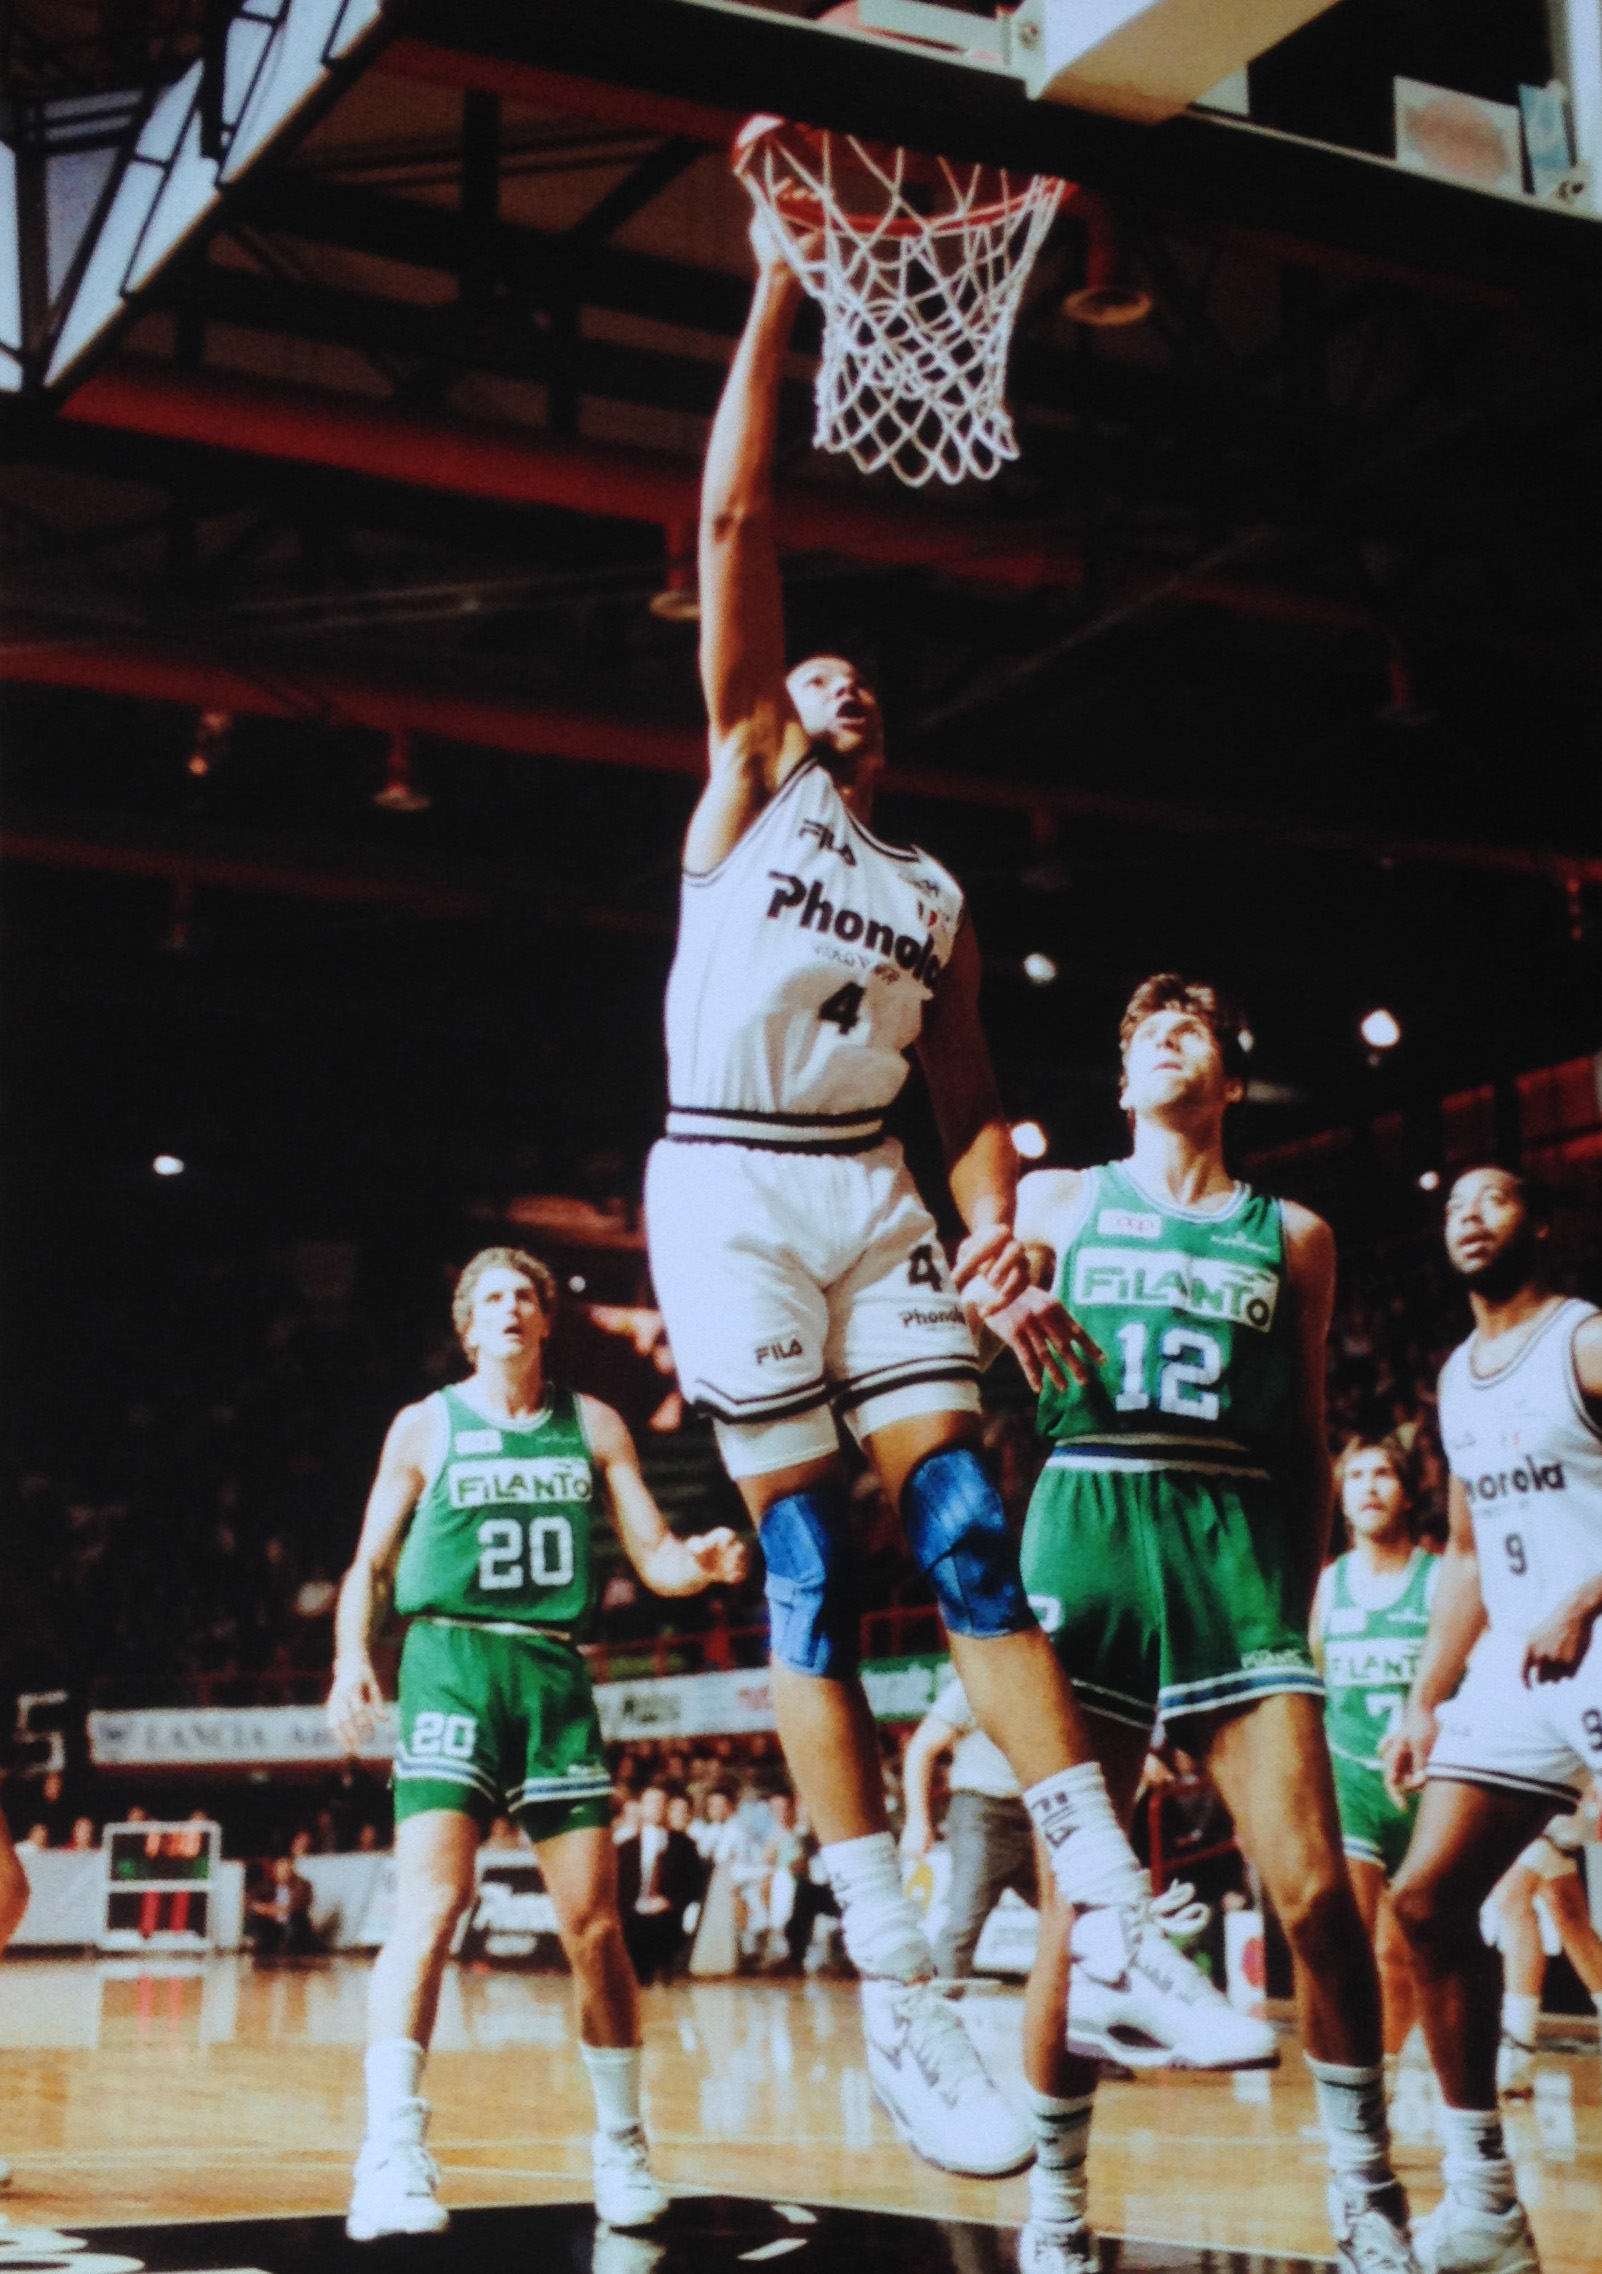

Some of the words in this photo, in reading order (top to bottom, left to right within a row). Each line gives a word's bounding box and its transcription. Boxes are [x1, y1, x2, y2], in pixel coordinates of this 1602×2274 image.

[818, 982, 866, 1036] 4
[906, 1244, 943, 1293] 4
[755, 1338, 805, 1365] FILA
[1114, 1321, 1220, 1422] 12
[476, 1515, 575, 1591] 20
[1504, 1532, 1528, 1576] 9
[411, 1711, 478, 1760] 20
